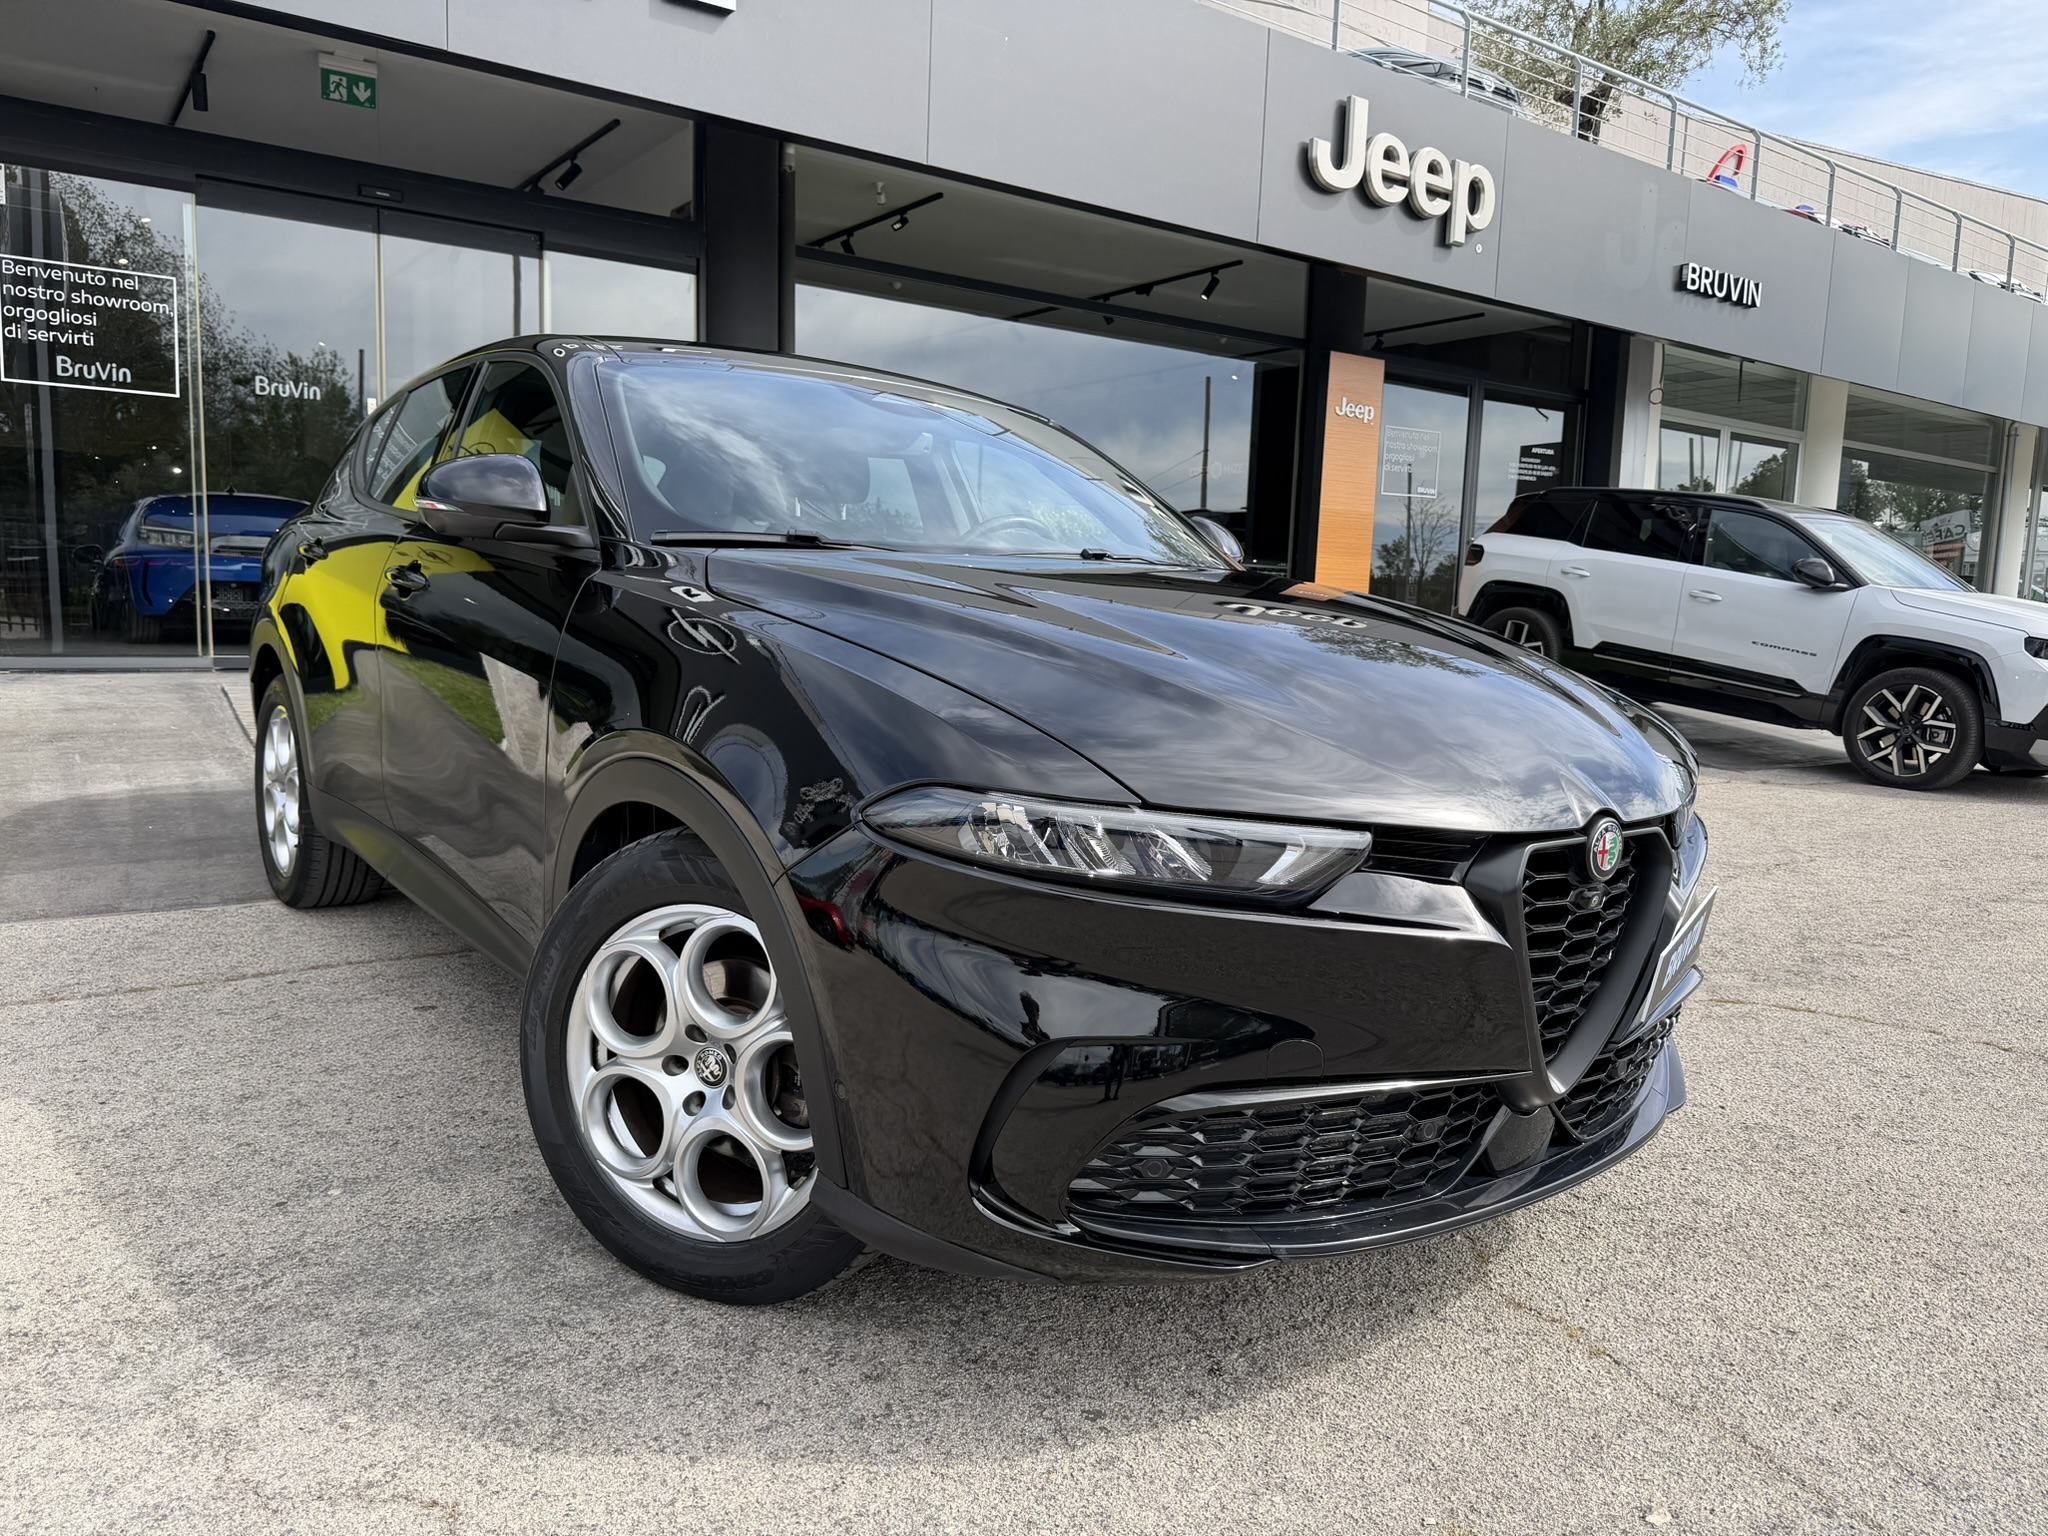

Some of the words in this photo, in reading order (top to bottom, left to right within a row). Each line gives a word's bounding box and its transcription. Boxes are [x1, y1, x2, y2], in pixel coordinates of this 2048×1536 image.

[1308, 94, 1496, 247] Jeep
[2, 259, 106, 287] Benvenuto
[112, 275, 139, 290] nel
[1686, 262, 1762, 308] BRUVIN
[3, 283, 65, 302] nostro
[71, 289, 174, 317] showroom,
[3, 305, 97, 326] orgogliosi
[4, 322, 21, 339] di
[28, 327, 94, 346] servirti
[56, 355, 131, 383] BruVin
[255, 375, 321, 401] BruVin
[1335, 396, 1375, 424] Jeep
[1751, 640, 1818, 657] COMPASS
